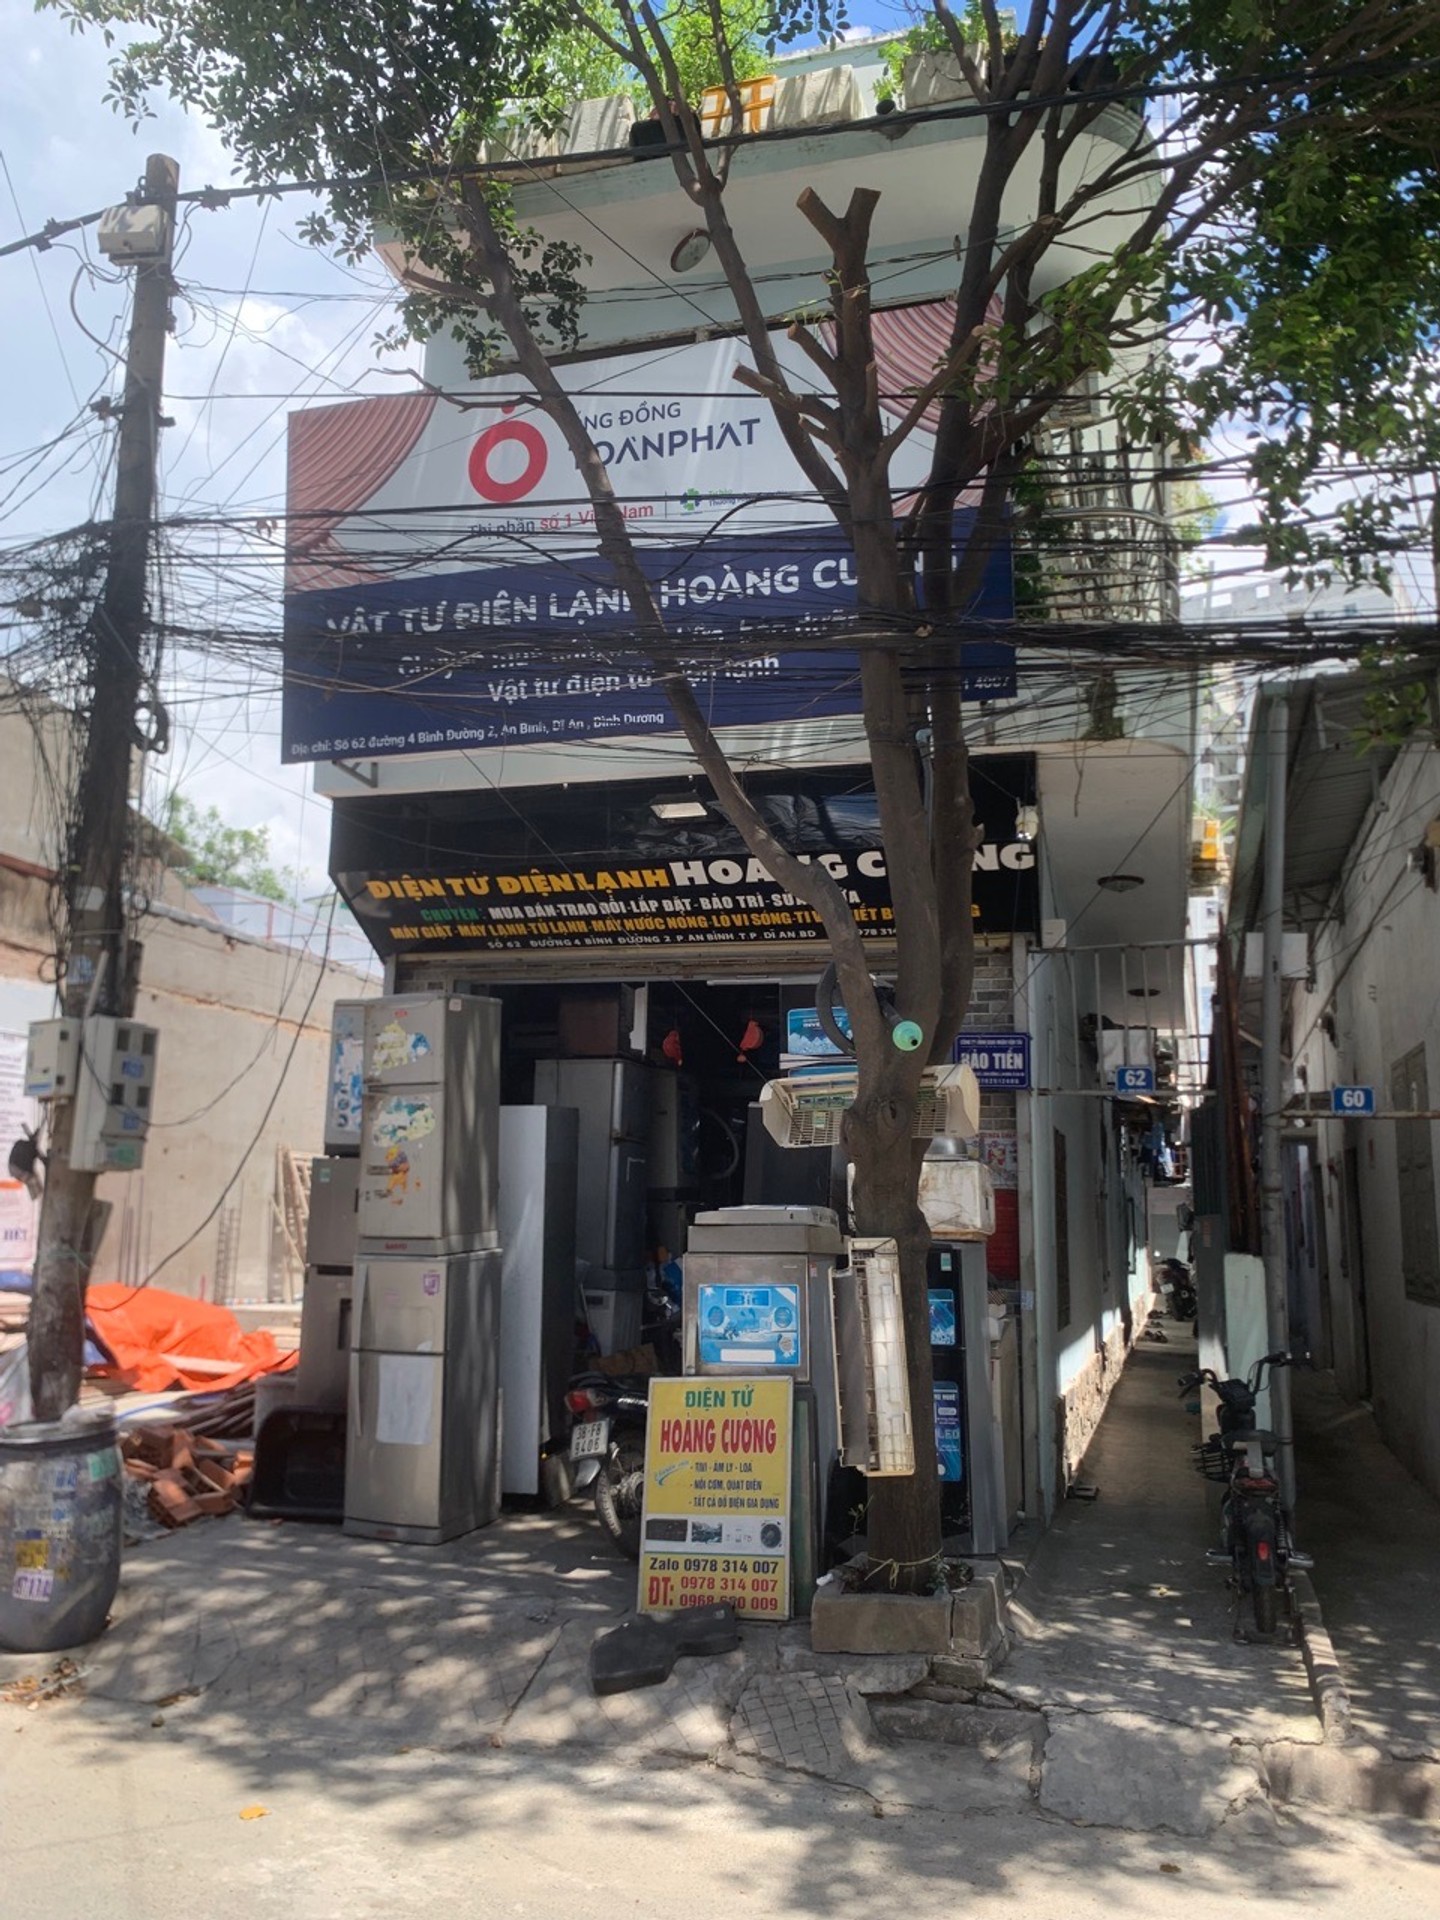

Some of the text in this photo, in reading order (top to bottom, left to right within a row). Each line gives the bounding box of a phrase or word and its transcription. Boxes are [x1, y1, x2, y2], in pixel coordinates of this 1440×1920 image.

[577, 401, 681, 430] NG ĐỒNG
[540, 512, 560, 530] số
[660, 565, 799, 607] HOÀNG
[352, 737, 365, 749] 62
[407, 733, 415, 743] 4
[418, 730, 443, 744] Bình
[446, 871, 489, 897] TỬ
[488, 906, 524, 920] MUA
[663, 897, 692, 916] ĐẶT
[700, 893, 733, 910] BẢO
[390, 924, 420, 940] MÁY
[732, 913, 749, 926] VI
[689, 933, 704, 942] AN
[992, 1047, 1023, 1069] TIẾN
[1125, 1070, 1147, 1086] 62
[1342, 1090, 1365, 1107] 60
[685, 1384, 754, 1411] ĐIỆN TỬ
[649, 1557, 779, 1574] Zalo 0978 314 007
[681, 1577, 715, 1590] 0978
[720, 1578, 746, 1591] 314
[751, 1579, 778, 1592] 007
[751, 1596, 778, 1610] 009
